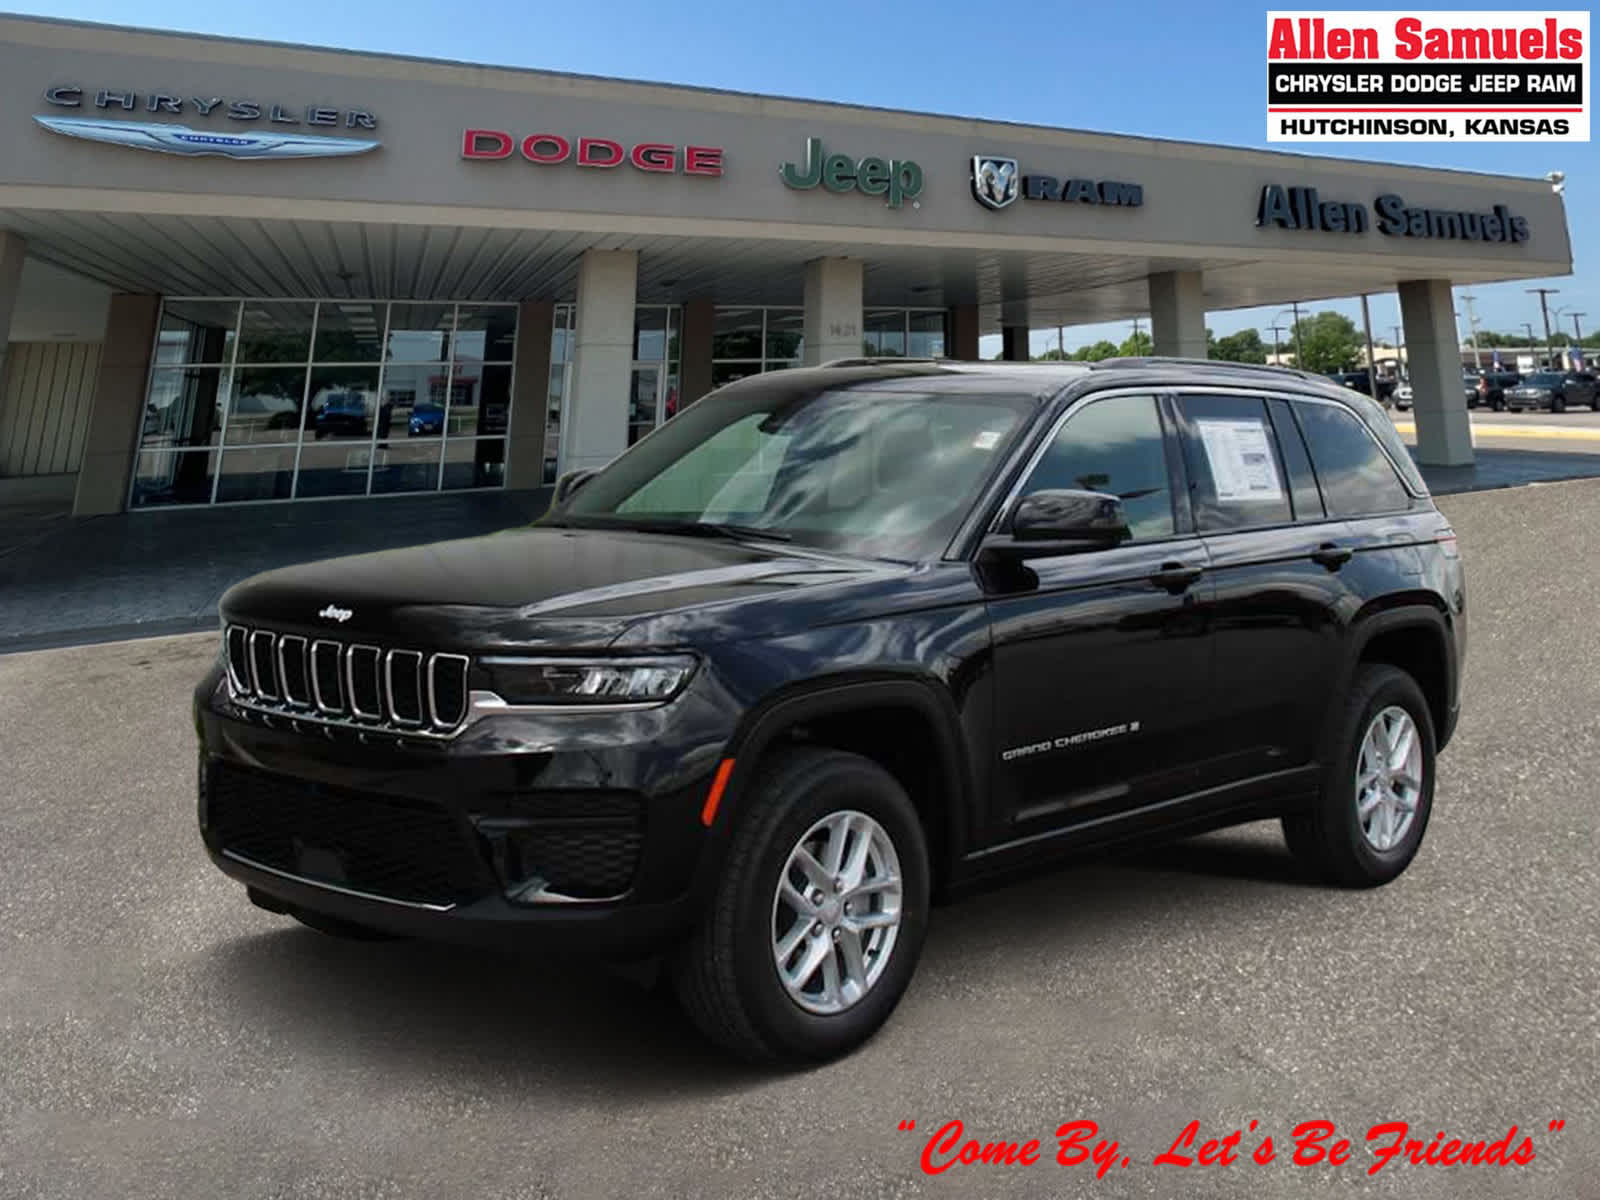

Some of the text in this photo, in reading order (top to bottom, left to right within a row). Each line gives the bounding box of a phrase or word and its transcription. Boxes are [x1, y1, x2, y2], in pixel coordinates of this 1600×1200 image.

[44, 86, 378, 129] CHRYSLER
[461, 128, 725, 176] DODGE
[780, 137, 923, 208] Jeep
[1022, 175, 1144, 207] RAM
[1256, 183, 1531, 243] Allen Samuels
[319, 604, 353, 622] Jeep
[1002, 724, 1127, 760] GRAND CHEROKEE
